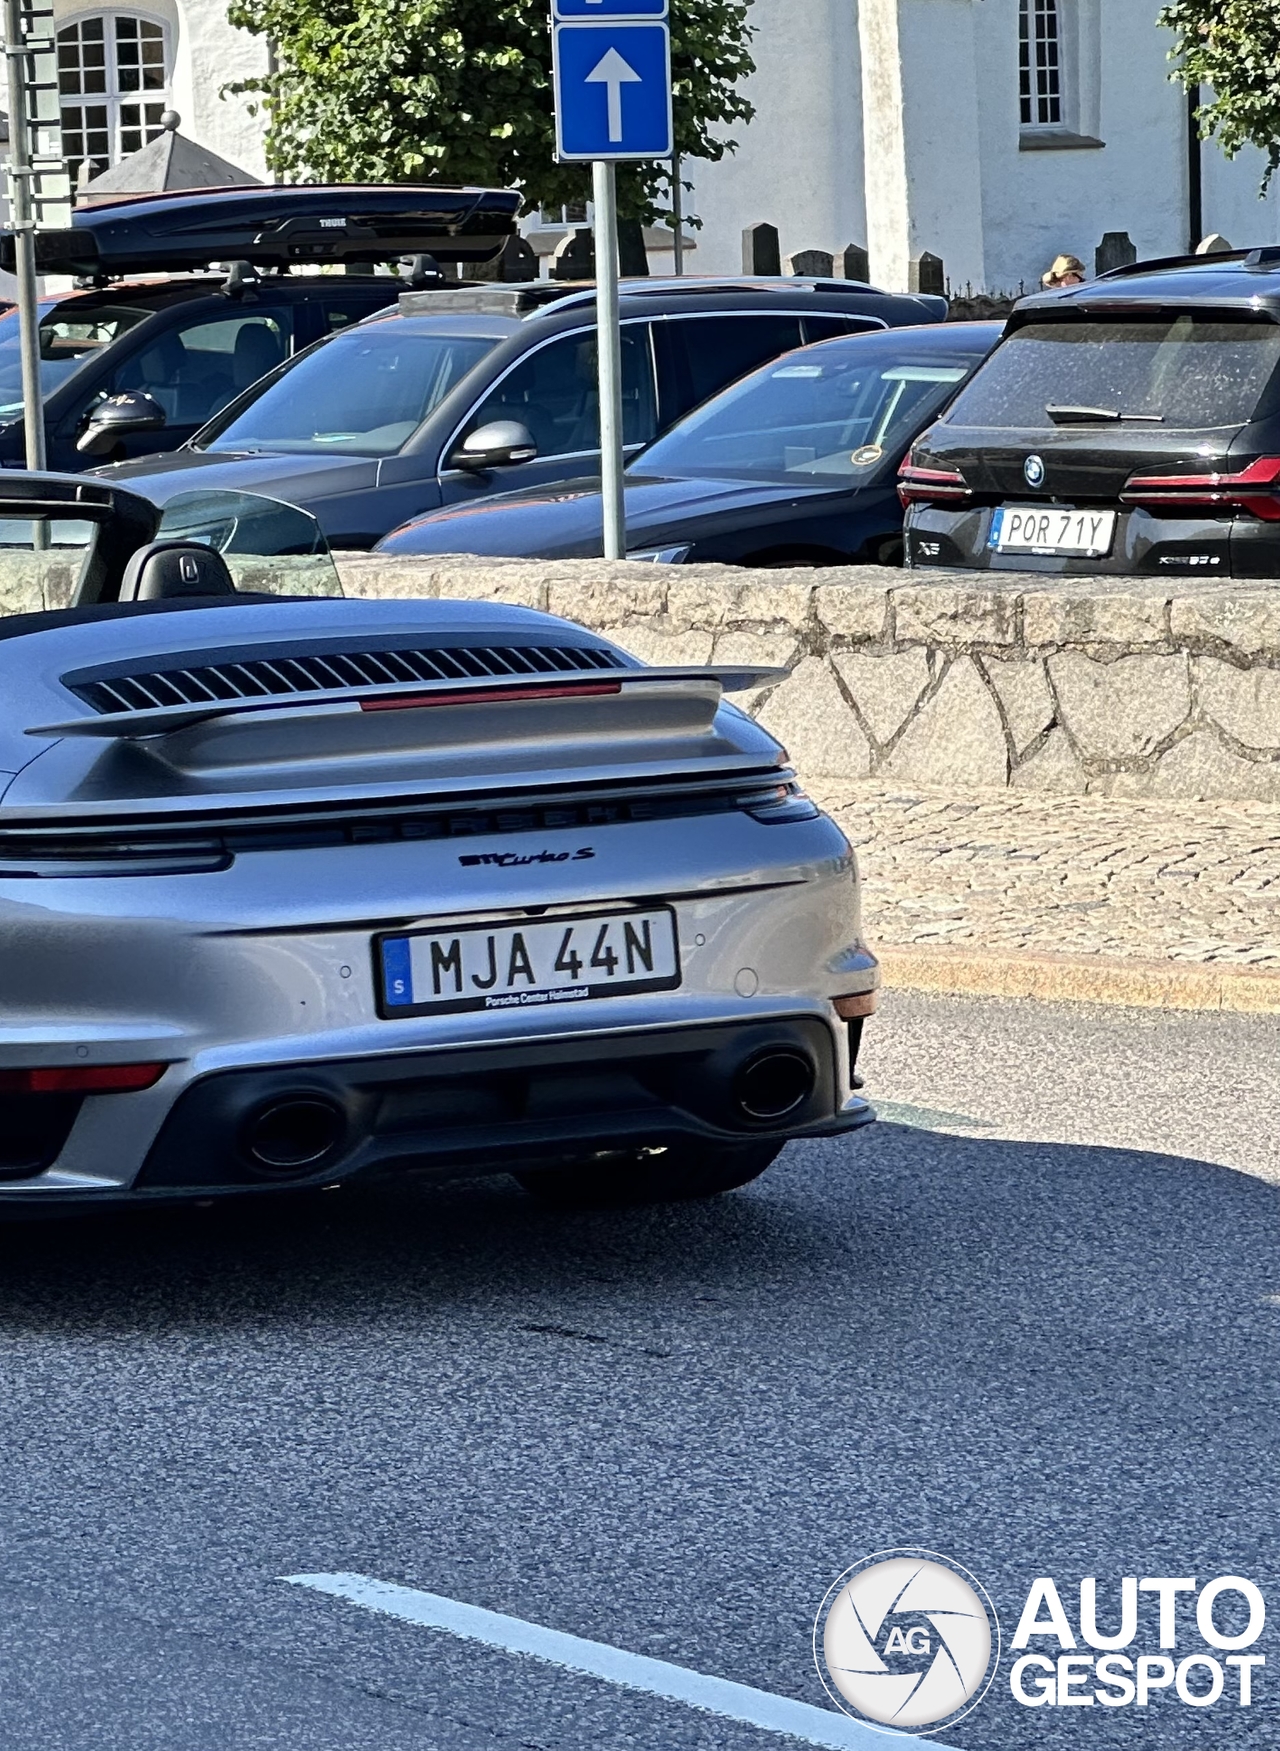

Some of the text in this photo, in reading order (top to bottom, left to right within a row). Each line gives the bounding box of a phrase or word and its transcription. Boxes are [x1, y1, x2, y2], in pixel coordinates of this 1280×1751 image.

[319, 218, 346, 227] THULE
[1007, 514, 1104, 546] POR 71Y
[429, 919, 654, 995] MJA 44N
[393, 979, 405, 994] S
[485, 995, 520, 1007] Porsche
[520, 993, 548, 1004] Center
